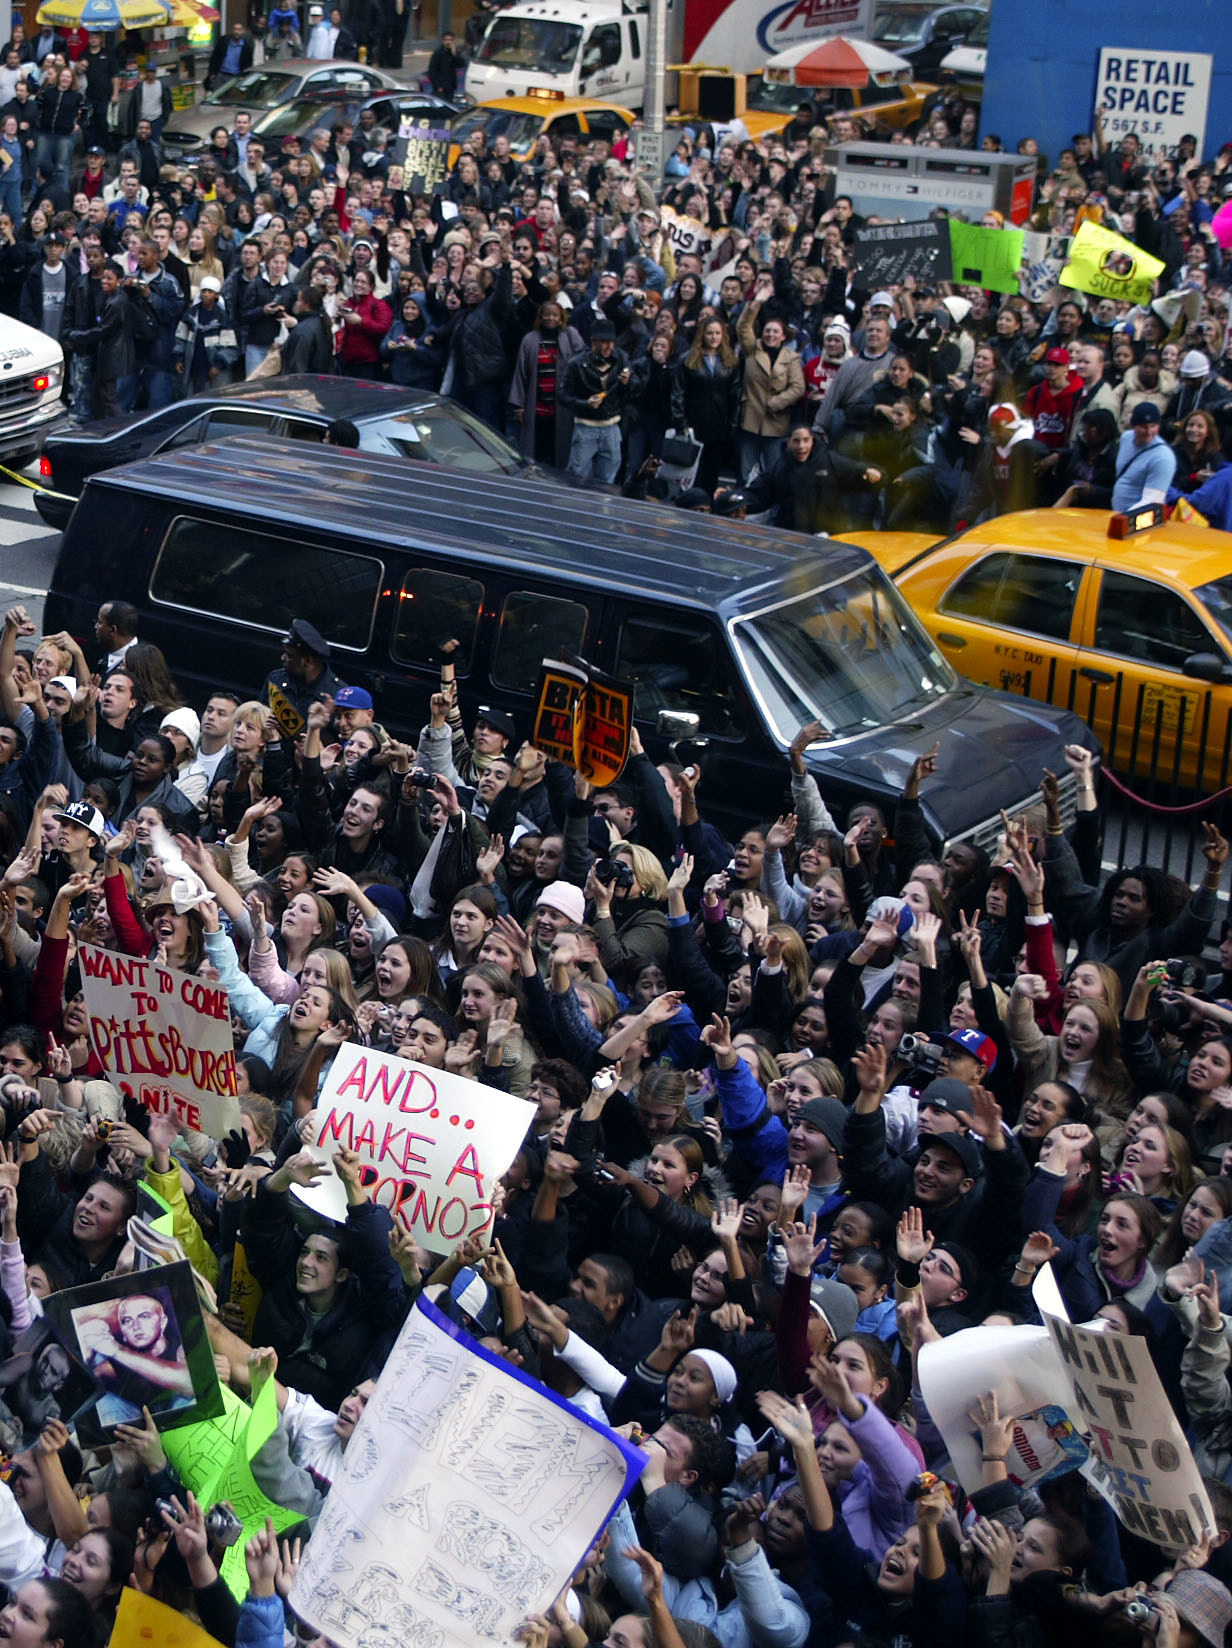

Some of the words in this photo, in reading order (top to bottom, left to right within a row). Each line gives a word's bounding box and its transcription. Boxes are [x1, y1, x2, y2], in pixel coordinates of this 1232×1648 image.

[1105, 58, 1195, 87] RETAIL
[1102, 86, 1186, 116] SPACE
[848, 179, 901, 193] TOMMY
[1023, 653, 1043, 666] TAXI
[67, 800, 89, 816] NY
[79, 945, 149, 987] WANT
[155, 968, 174, 994] TO
[181, 979, 229, 1022] COME
[130, 991, 159, 1015] TO
[317, 1107, 436, 1180] MAKE
[445, 1143, 485, 1198] A
[1013, 1425, 1042, 1473] eminem
